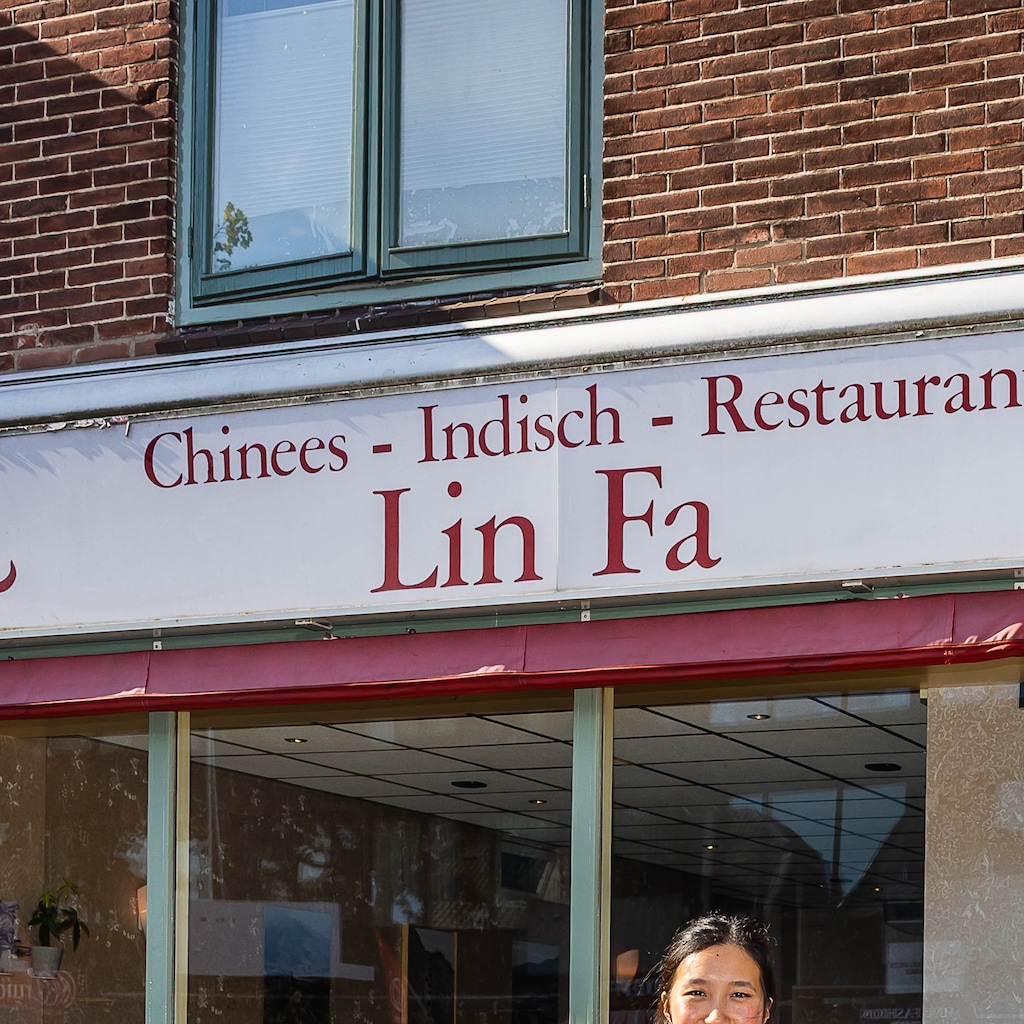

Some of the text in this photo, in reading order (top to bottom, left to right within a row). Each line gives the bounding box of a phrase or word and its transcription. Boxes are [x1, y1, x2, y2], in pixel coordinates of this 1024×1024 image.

[144, 428, 349, 488] Chinees
[417, 384, 624, 463] Indisch
[371, 465, 722, 593] Lin Fa
